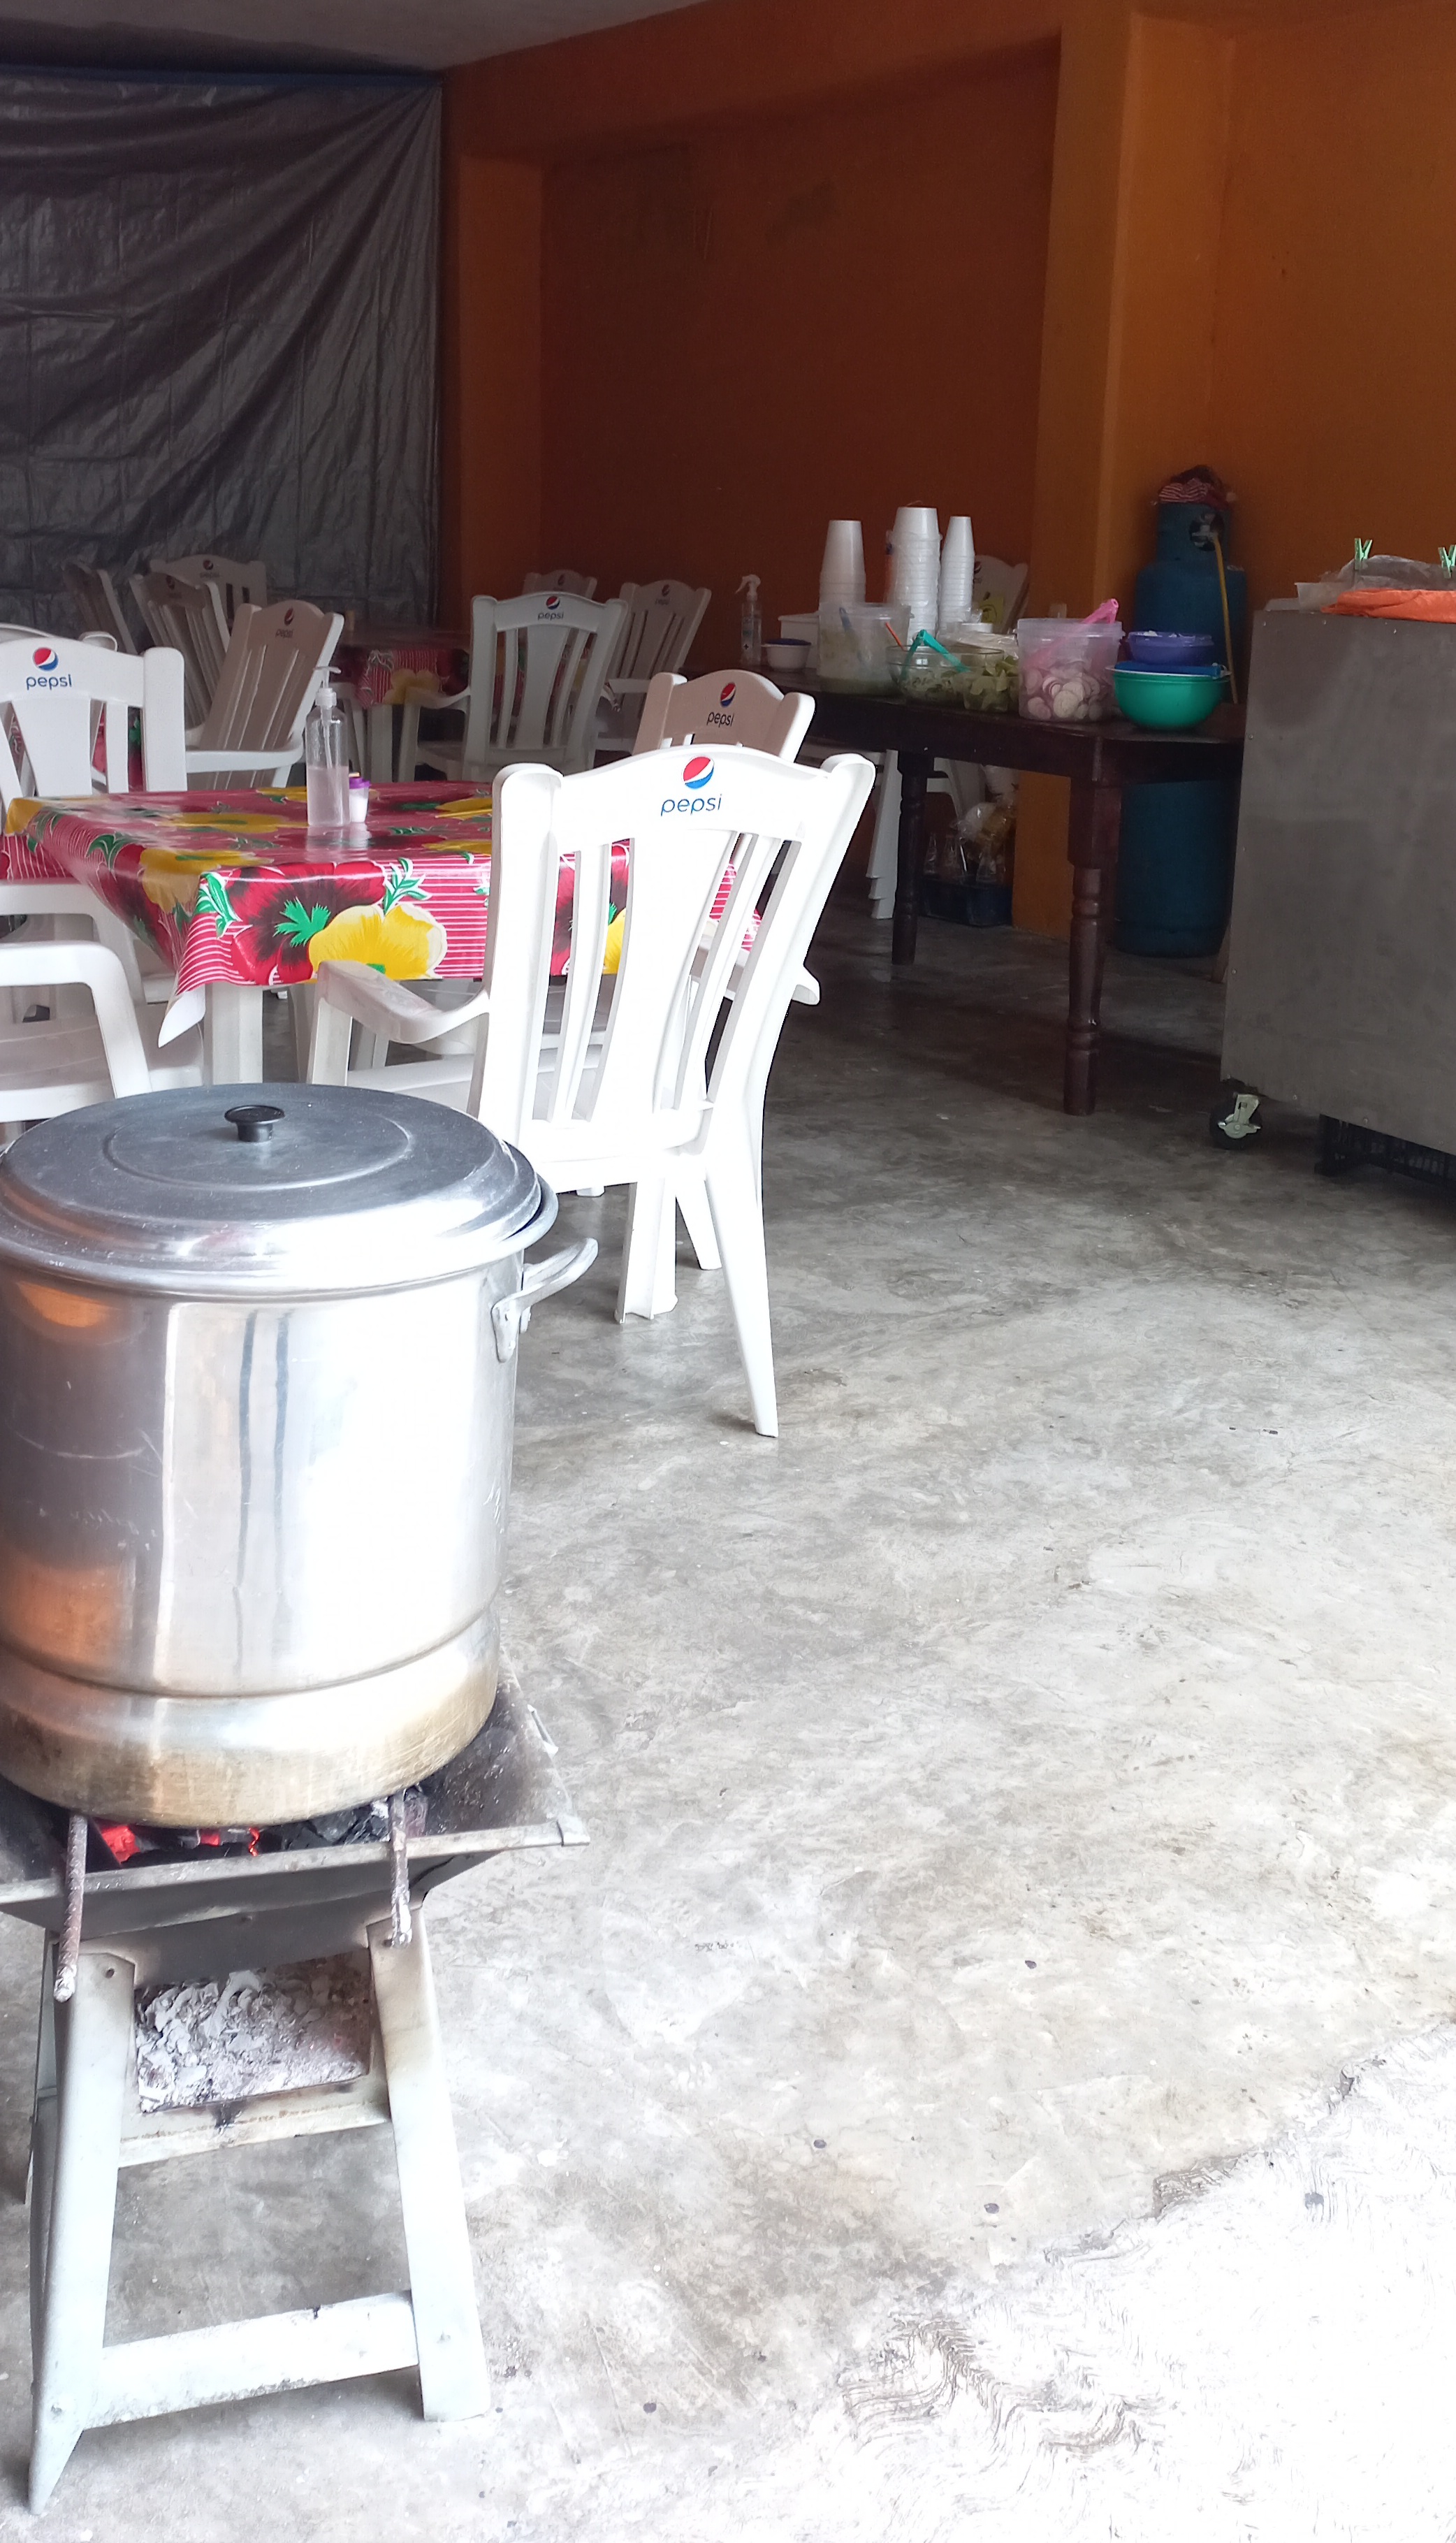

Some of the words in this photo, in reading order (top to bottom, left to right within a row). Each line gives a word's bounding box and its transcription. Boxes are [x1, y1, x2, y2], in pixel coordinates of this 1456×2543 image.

[537, 611, 564, 621] pepsi
[26, 674, 72, 690] pepsi
[706, 711, 734, 727] pepsi
[661, 793, 722, 816] pepsi
